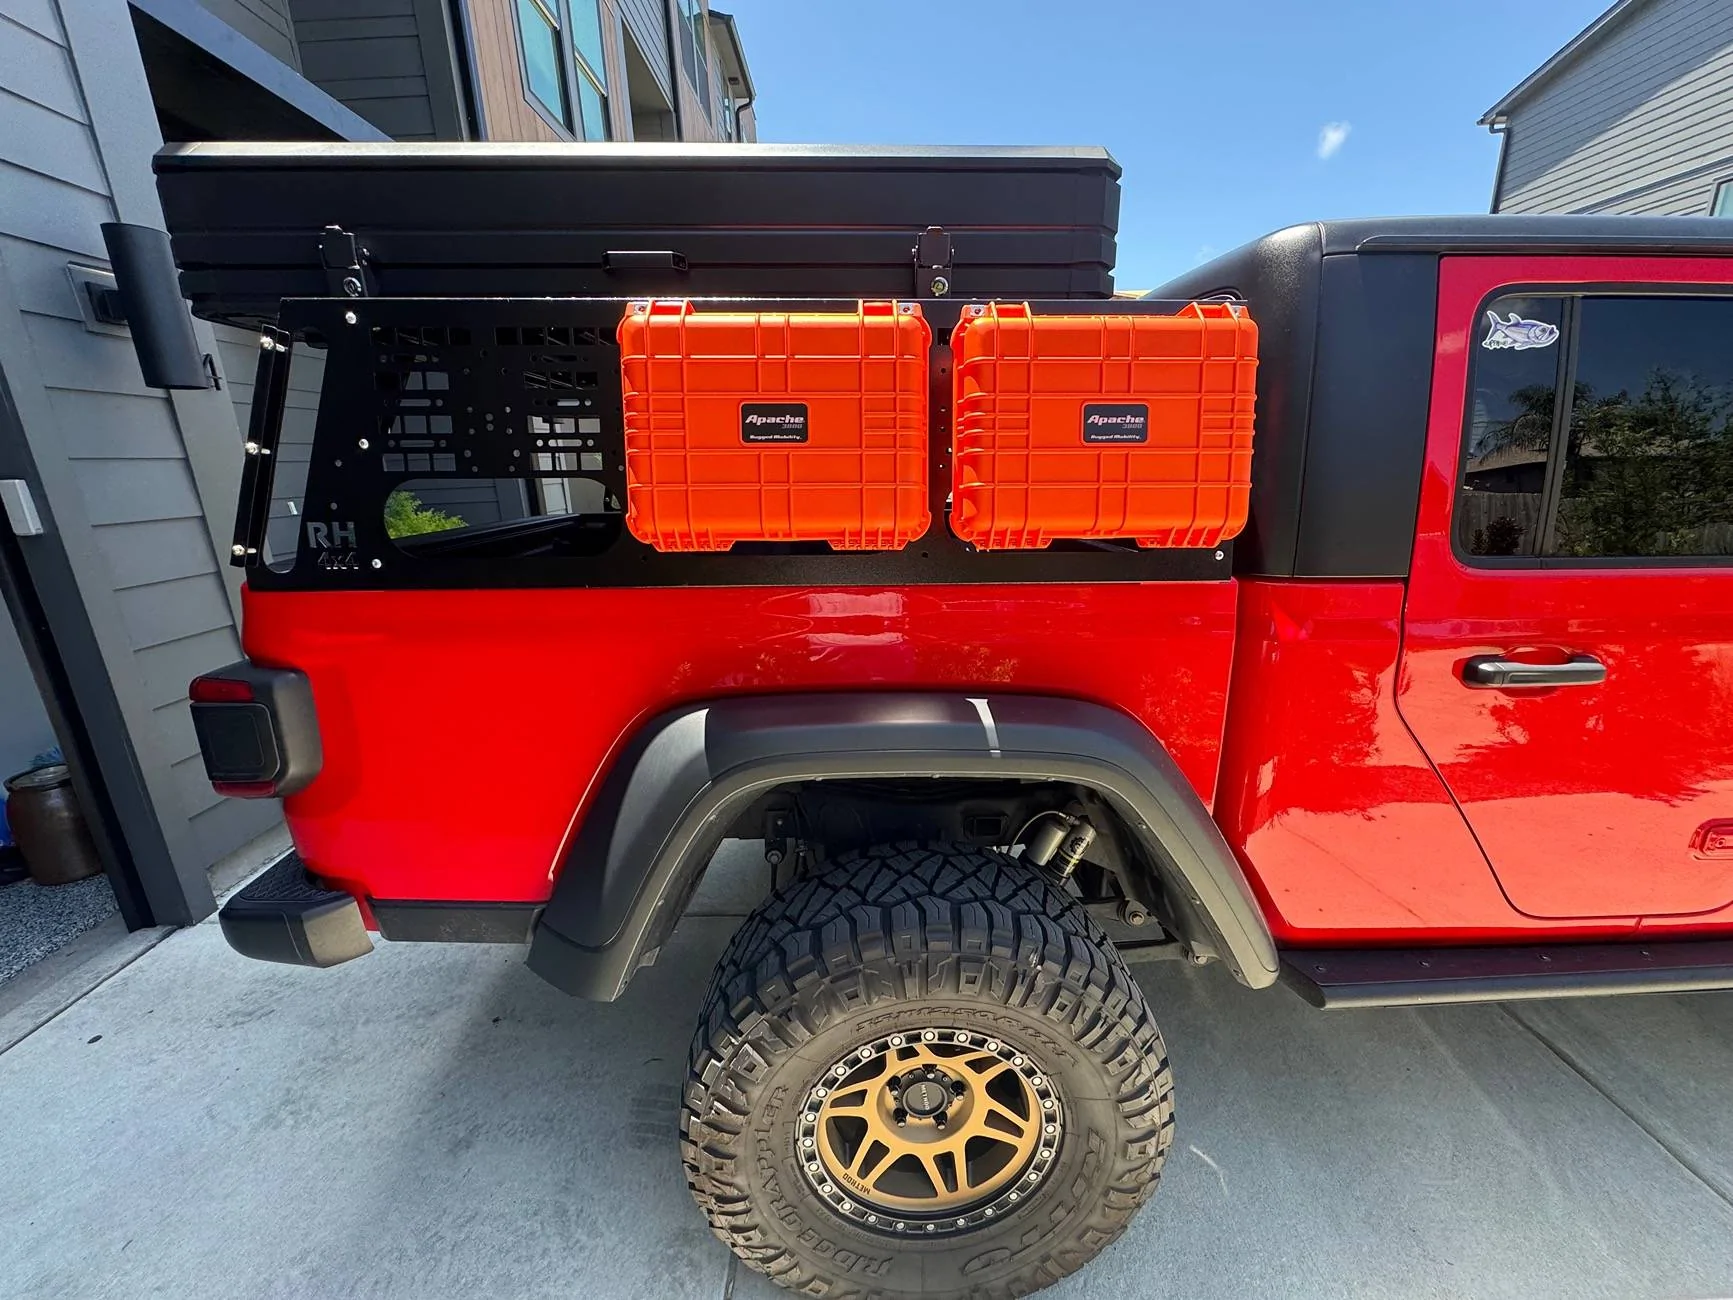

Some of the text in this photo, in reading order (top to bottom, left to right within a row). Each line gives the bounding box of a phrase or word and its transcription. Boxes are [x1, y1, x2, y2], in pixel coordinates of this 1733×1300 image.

[745, 414, 805, 426] Apache
[1087, 414, 1145, 426] Apache
[306, 521, 358, 548] RH
[842, 1172, 871, 1195] METHOD
